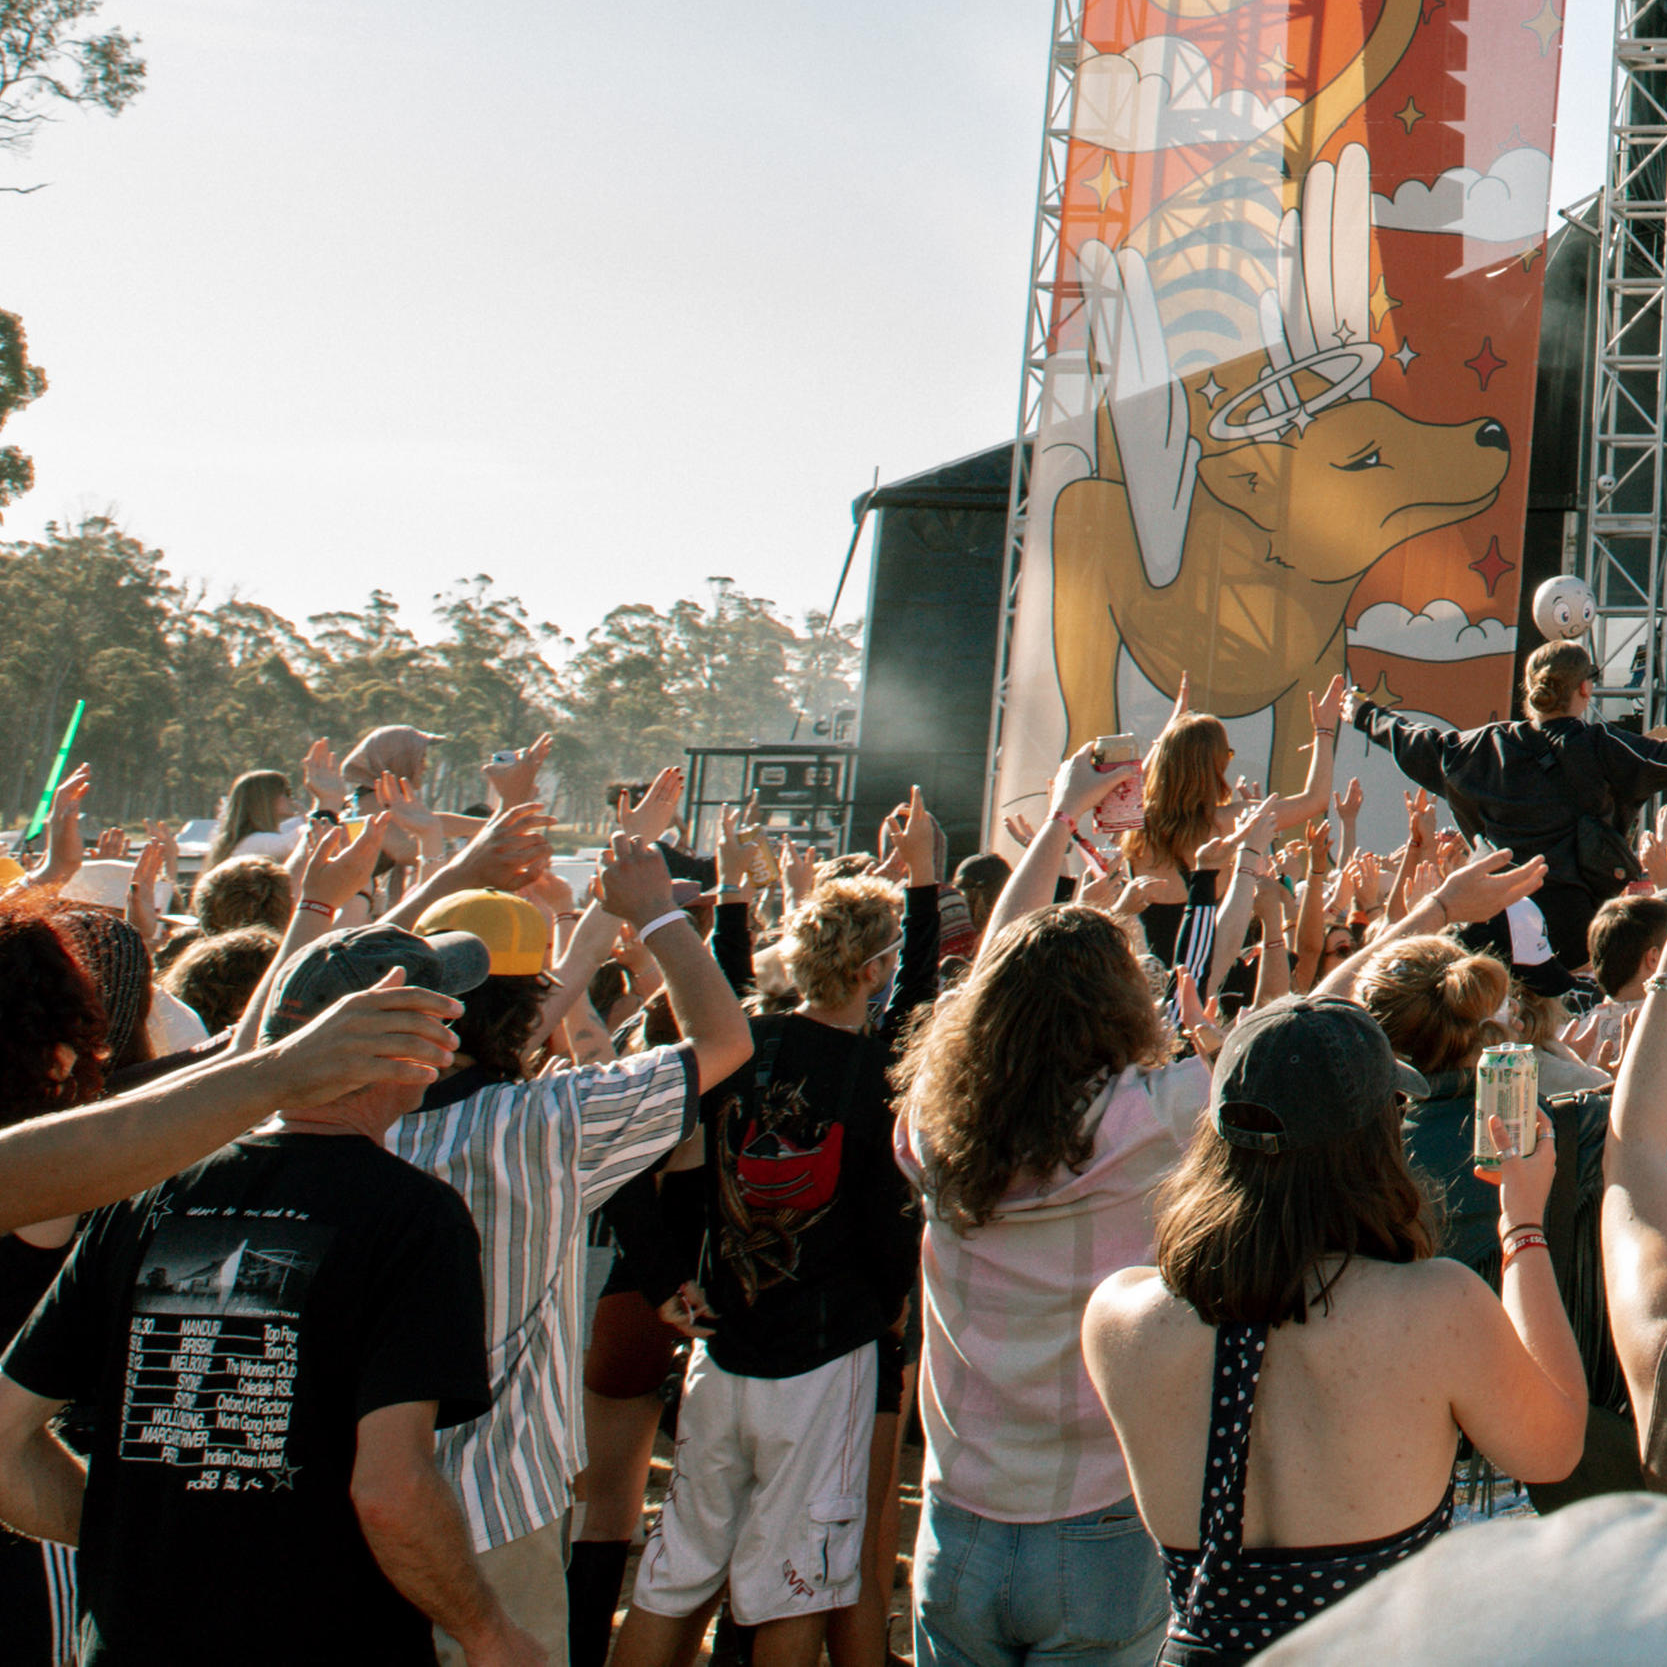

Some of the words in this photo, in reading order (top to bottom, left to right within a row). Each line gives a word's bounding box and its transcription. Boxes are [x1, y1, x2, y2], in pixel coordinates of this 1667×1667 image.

[264, 1324, 280, 1344] Top
[264, 1342, 284, 1359] Tom
[284, 1344, 297, 1360] Ca
[226, 1358, 240, 1375] The
[240, 1359, 276, 1377] Workers
[276, 1361, 297, 1378] Club
[274, 1379, 294, 1396] RSL
[216, 1393, 245, 1412] Oxford
[244, 1396, 258, 1413] Art
[258, 1397, 292, 1417] Factory
[216, 1411, 240, 1430] North
[240, 1414, 264, 1436] Gong
[263, 1415, 290, 1432] Hotel
[246, 1432, 262, 1450] The
[261, 1433, 287, 1450] River
[203, 1448, 231, 1465] Indian
[231, 1449, 258, 1468] Ocean
[257, 1451, 284, 1469] Hotel
[187, 1480, 219, 1491] POND
